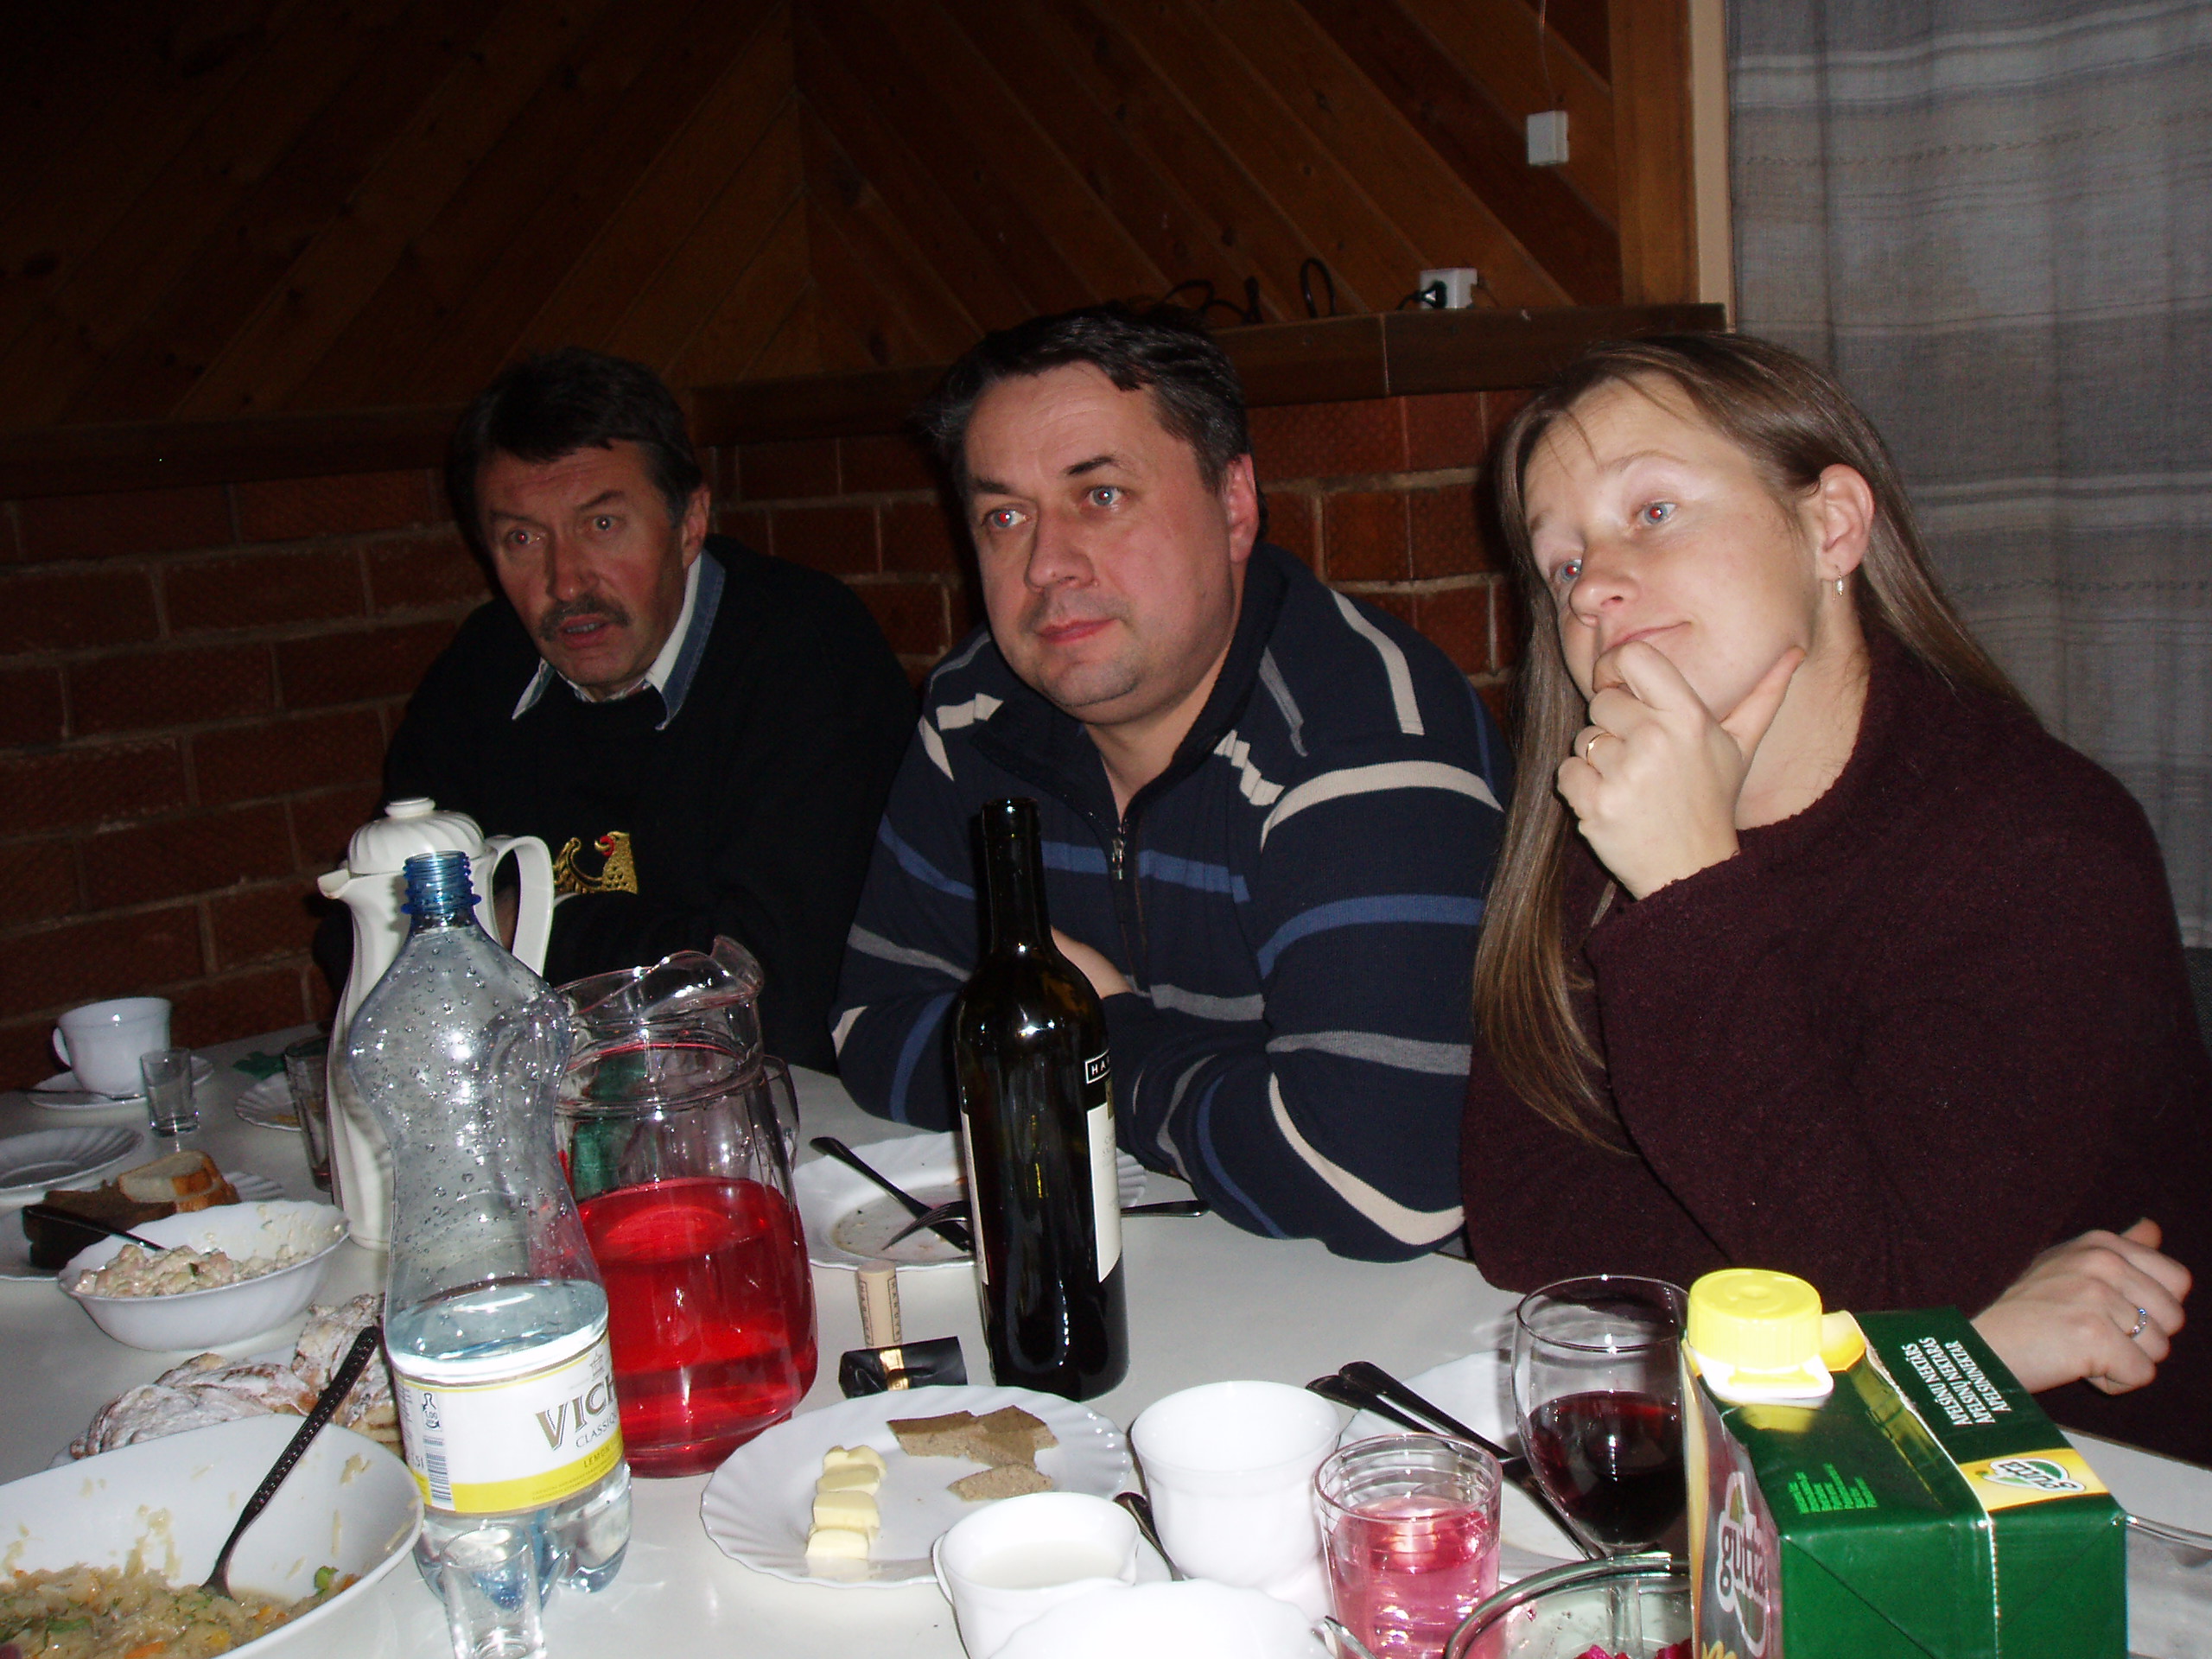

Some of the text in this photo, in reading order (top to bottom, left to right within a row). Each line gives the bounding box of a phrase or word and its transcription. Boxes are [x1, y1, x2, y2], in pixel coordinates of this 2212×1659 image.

[1918, 1337, 1964, 1382] NEKTARAS
[1944, 1340, 2012, 1412] APELSININEKTAR
[583, 1447, 610, 1468] LEMON
[1998, 1460, 2078, 1490] gutta
[1719, 1524, 1766, 1599] gutta
